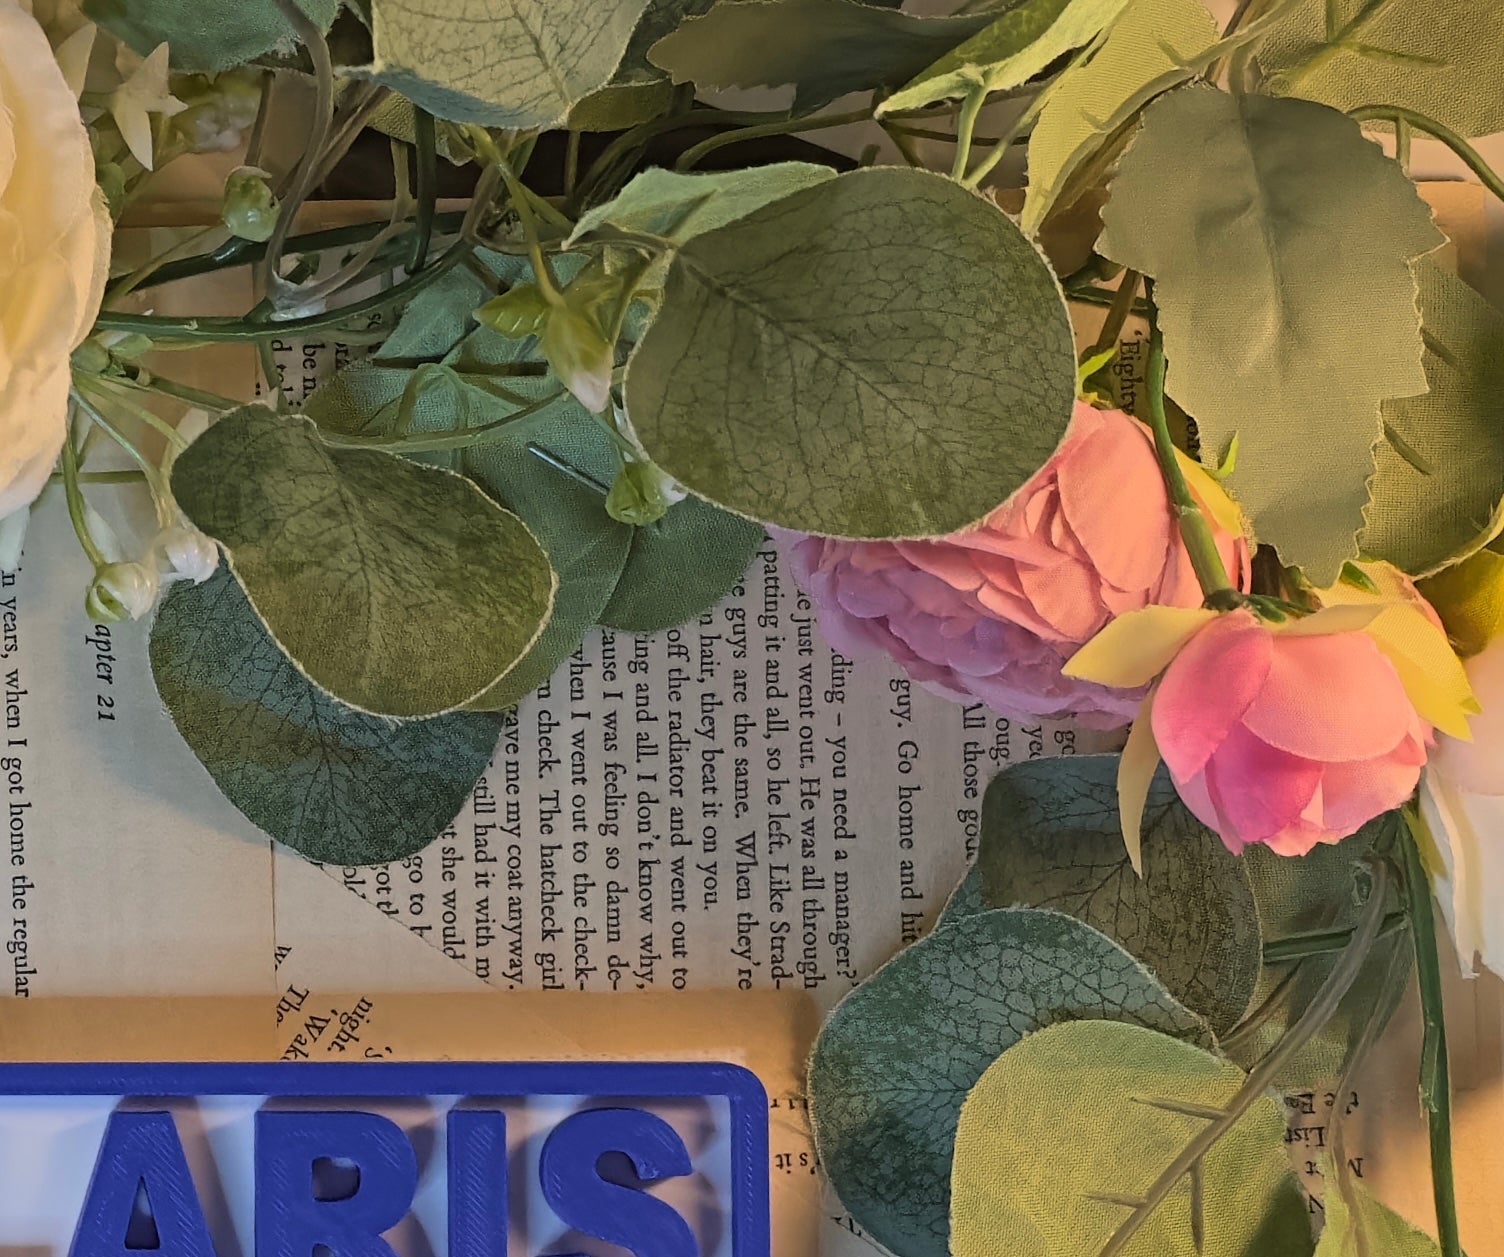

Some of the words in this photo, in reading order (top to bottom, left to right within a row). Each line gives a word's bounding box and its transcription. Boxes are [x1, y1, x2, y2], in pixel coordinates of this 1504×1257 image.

[752, 550, 780, 629] patting
[764, 634, 786, 652] it
[4, 667, 29, 730] when
[764, 658, 788, 700] and
[96, 693, 116, 721] 21
[761, 706, 789, 740] all,
[888, 677, 912, 728] guy.
[6, 737, 28, 747] I
[536, 708, 561, 779] check.
[765, 746, 781, 771] so
[896, 739, 919, 774] Go
[0, 756, 25, 794] got
[766, 776, 790, 806] he
[8, 800, 32, 866] home
[537, 788, 562, 835] The
[766, 811, 792, 855] left.
[897, 783, 922, 850] home
[11, 874, 35, 910] the
[539, 842, 565, 942] hatcheck
[768, 862, 793, 913] Like
[899, 859, 924, 901] and
[899, 910, 926, 943] hit
[5, 916, 37, 999] regular
[534, 951, 565, 992] girl
[768, 920, 794, 991] Strad-
[326, 995, 373, 1052] night.
